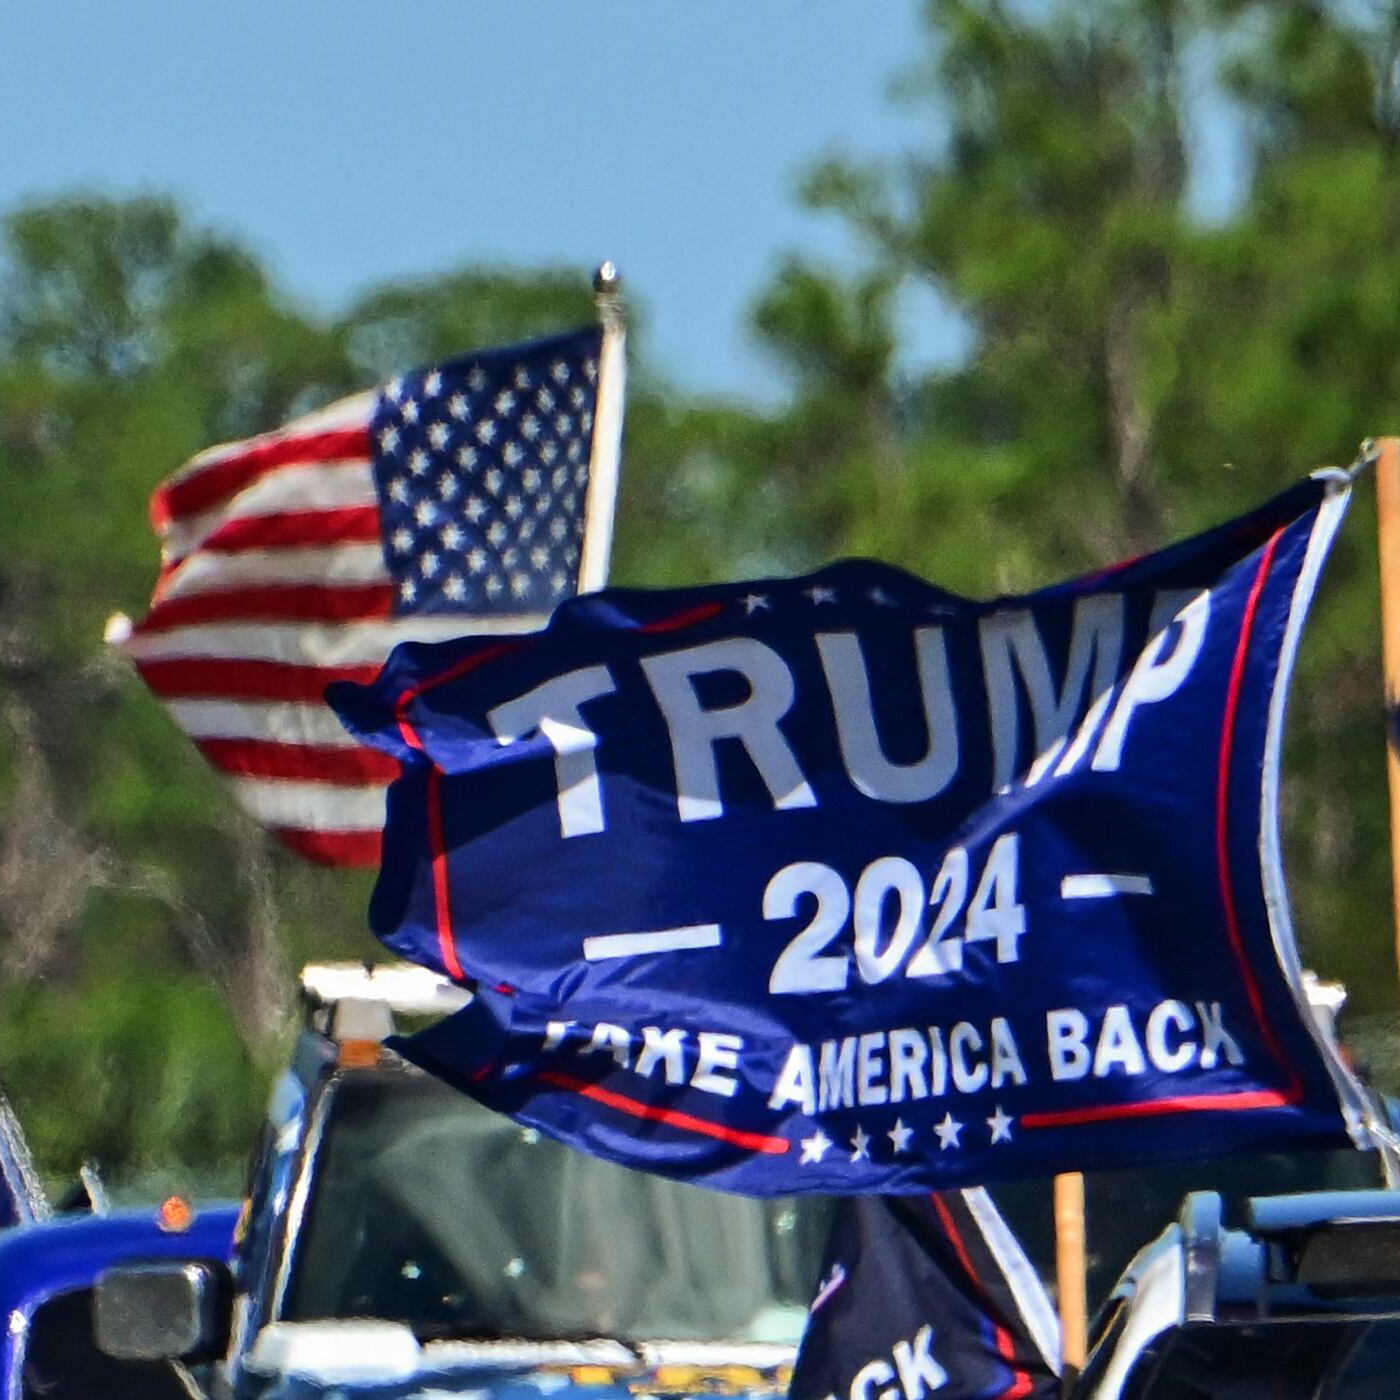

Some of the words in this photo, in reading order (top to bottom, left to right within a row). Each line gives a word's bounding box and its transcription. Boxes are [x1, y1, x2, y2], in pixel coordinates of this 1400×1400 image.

[486, 587, 1211, 839] TRUMP
[762, 832, 1027, 994] 2024
[768, 1017, 1028, 1116] AMERICA
[1047, 998, 1245, 1082] BACK
